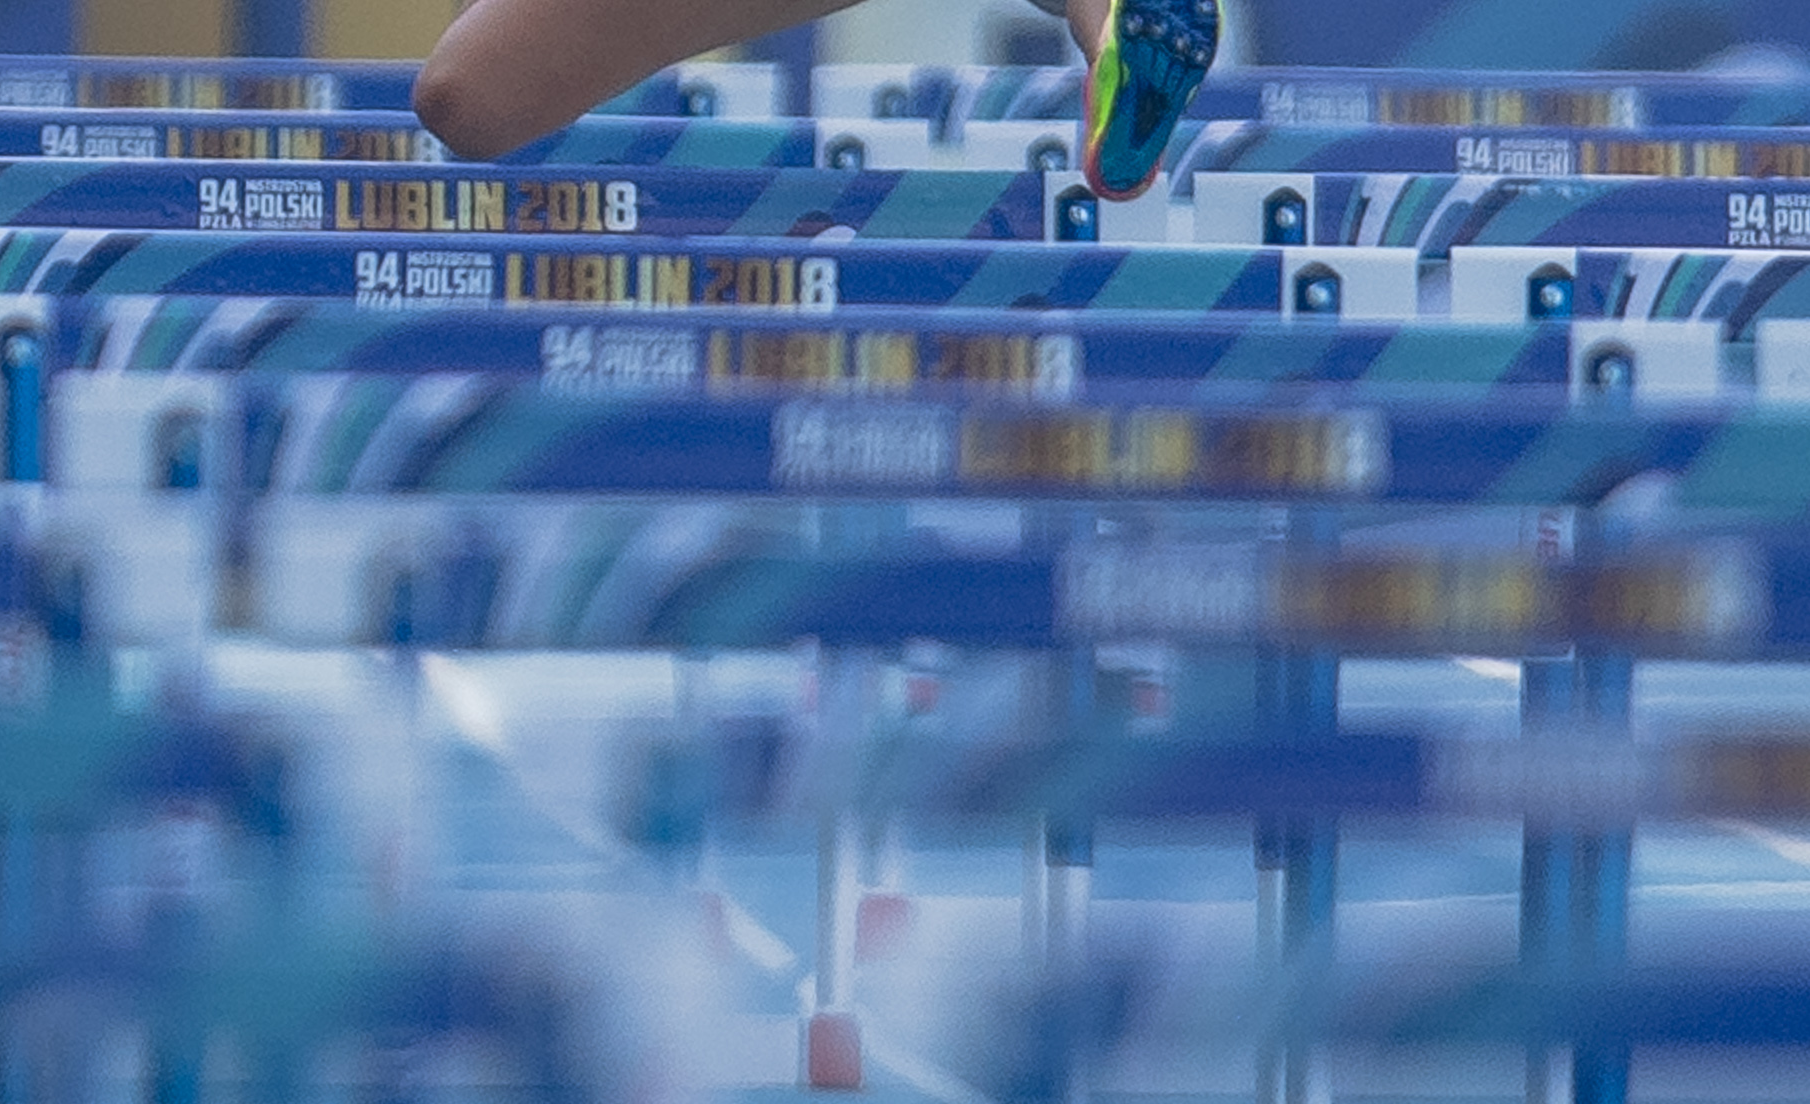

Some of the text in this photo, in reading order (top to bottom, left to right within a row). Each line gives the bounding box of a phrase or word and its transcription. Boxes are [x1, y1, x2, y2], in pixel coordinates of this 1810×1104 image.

[245, 193, 323, 219] POLSKI
[335, 179, 638, 232] LUBLIN 2018
[199, 214, 243, 230] PZLA
[1727, 230, 1771, 246] PZLA
[406, 267, 494, 295] POLSKI
[505, 252, 839, 313] LUBLIN 2018
